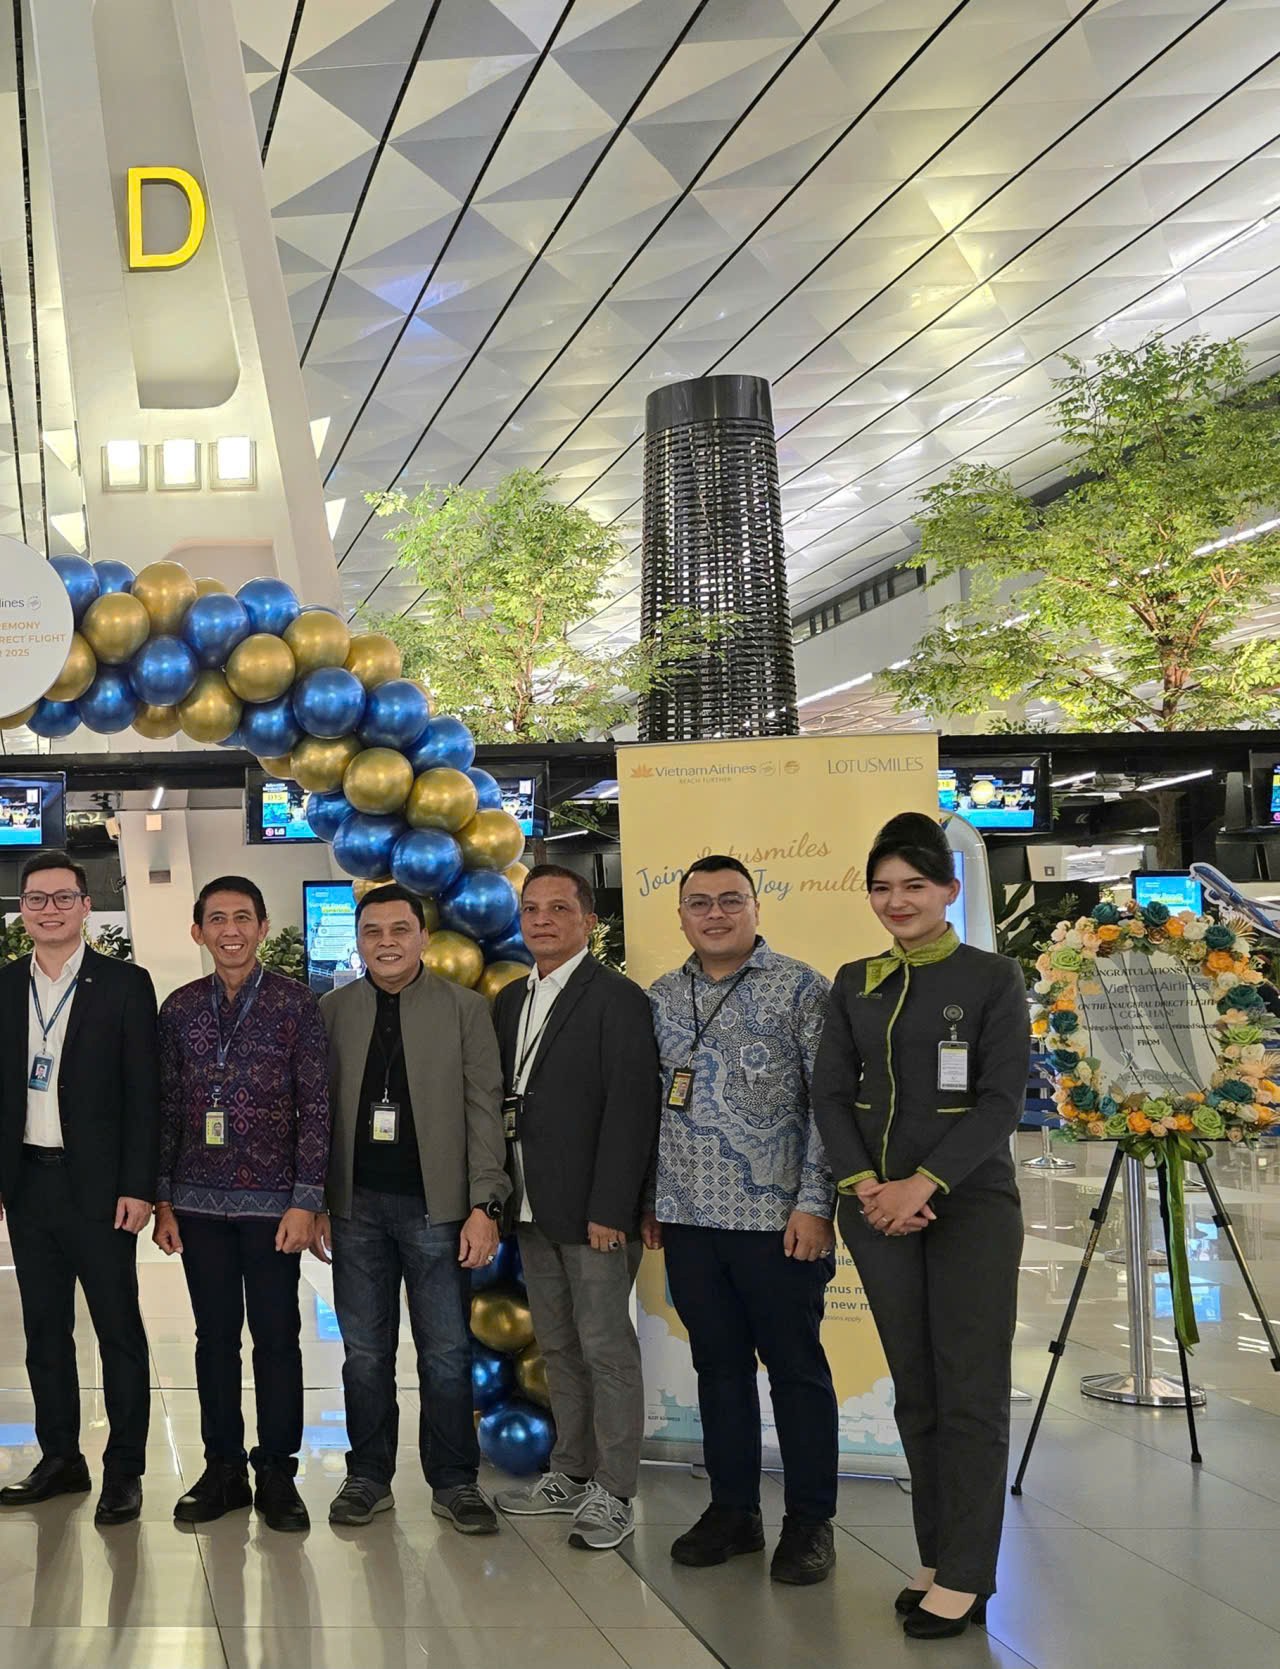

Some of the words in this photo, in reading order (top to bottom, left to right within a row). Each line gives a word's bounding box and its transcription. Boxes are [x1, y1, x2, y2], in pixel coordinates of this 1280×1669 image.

[128, 166, 206, 268] D
[28, 633, 67, 643] FLIGHT
[6, 648, 30, 657] 2025
[655, 766, 708, 777] Vietnam
[709, 764, 757, 774] Airlines
[827, 757, 924, 774] LOTUSMILES
[1105, 983, 1158, 994] Vietnam
[1161, 981, 1209, 991] Airlines
[824, 1286, 851, 1294] onus
[831, 1301, 857, 1309] new
